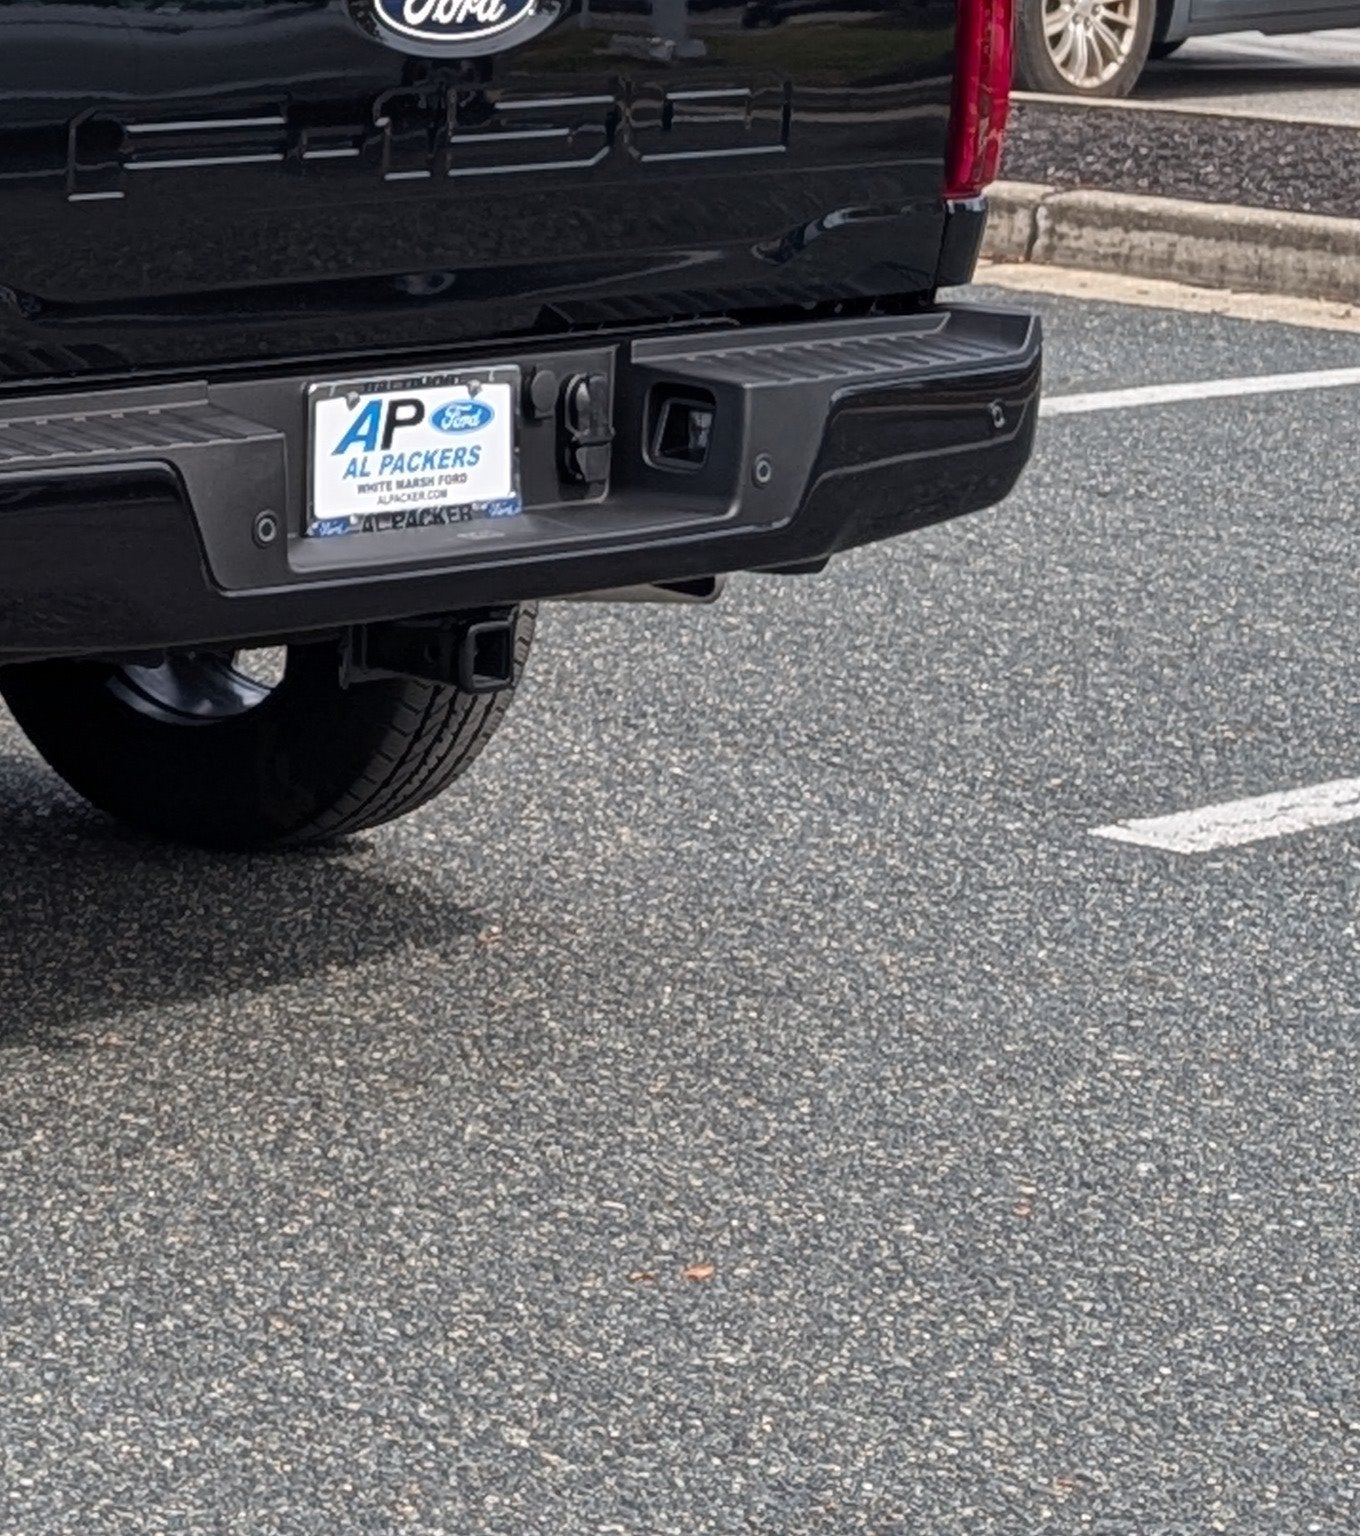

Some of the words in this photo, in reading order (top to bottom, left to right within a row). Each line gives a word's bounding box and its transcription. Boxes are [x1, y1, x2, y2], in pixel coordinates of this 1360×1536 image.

[331, 398, 425, 456] AP
[440, 401, 482, 431] Ford
[342, 457, 371, 480] AL
[378, 445, 482, 476] PACKERS
[357, 480, 392, 495] WHITE
[396, 476, 435, 491] MARSH
[438, 472, 468, 486] FORD
[376, 489, 448, 506] ALPACKER.COM
